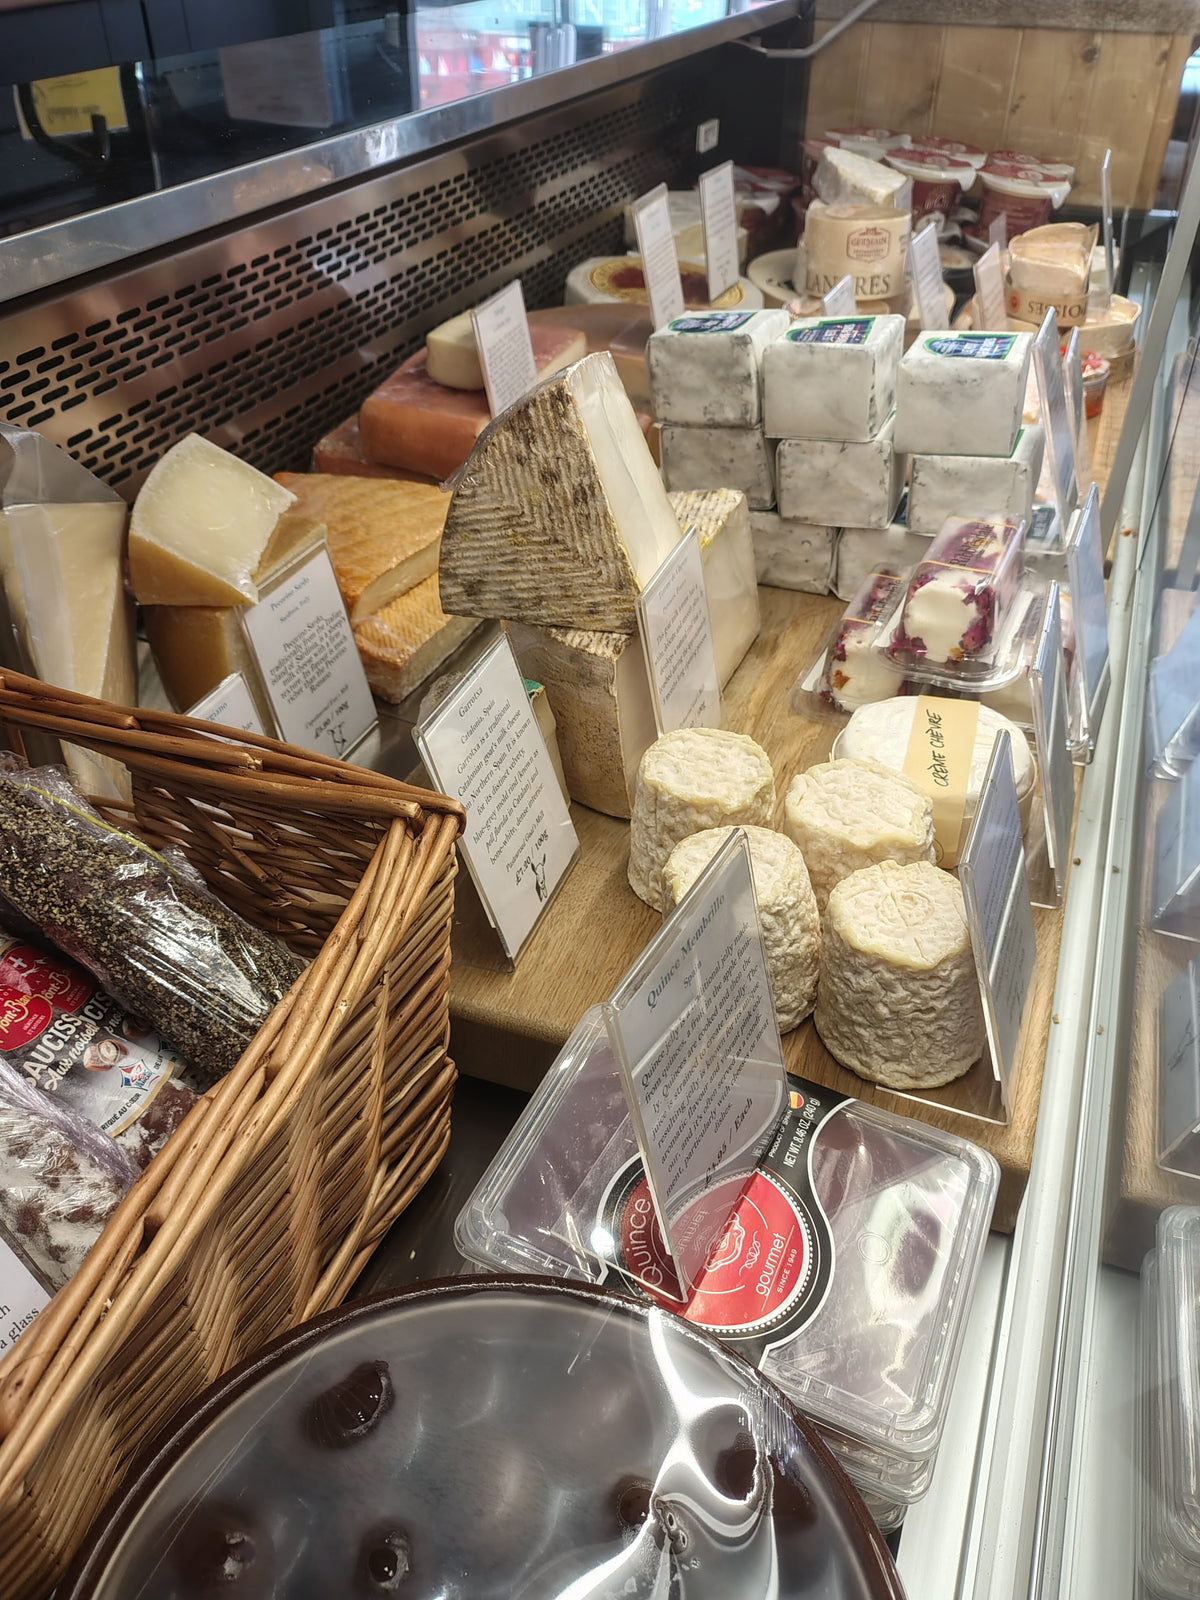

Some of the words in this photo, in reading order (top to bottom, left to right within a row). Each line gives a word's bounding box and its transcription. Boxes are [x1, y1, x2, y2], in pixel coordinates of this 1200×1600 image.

[457, 743, 480, 774] Garrotxa
[479, 736, 485, 745] is
[484, 731, 489, 739] a
[487, 699, 510, 733] traditional
[458, 686, 482, 717] Garrotxa
[460, 716, 484, 744] Catalonia,
[482, 699, 495, 716] Spain
[457, 761, 483, 796] Catalonian
[483, 742, 497, 765] goat's
[496, 727, 507, 744] milk
[506, 709, 520, 730] cheese
[470, 769, 494, 802] Northern
[510, 737, 516, 746] is
[515, 718, 530, 739] known
[476, 802, 486, 815] for
[484, 793, 492, 804] its
[491, 768, 509, 795] distinct
[507, 807, 514, 817] in
[512, 779, 531, 808] Catalan)
[530, 766, 538, 783] and
[472, 809, 497, 844] blue-grey
[495, 789, 509, 812] mold
[507, 775, 518, 794] rind
[516, 756, 533, 782] (known
[647, 959, 679, 1012] Quince
[681, 895, 724, 959] Membrillo
[641, 1050, 664, 1090] Quince
[664, 1026, 679, 1055] jelly
[720, 943, 733, 969] jelly
[645, 1077, 661, 1104] from
[661, 1039, 686, 1078] quinces,
[686, 1029, 691, 1038] a
[690, 1007, 704, 1030] fruit
[704, 997, 712, 1009] in
[712, 981, 722, 998] the
[722, 958, 737, 983] apple
[651, 1110, 666, 1141] juice
[673, 1056, 698, 1100] strained
[698, 1048, 706, 1060] to
[706, 1019, 724, 1048] create
[724, 1004, 733, 1020] the
[746, 964, 758, 982] The
[662, 1056, 686, 1101] Quinces
[687, 1040, 697, 1058] are
[697, 1005, 718, 1041] cooked
[718, 987, 729, 1009] and
[729, 970, 742, 993] then
[741, 956, 750, 971] the
[45, 1057, 74, 1091] Aux
[117, 1105, 129, 1118] AU
[657, 1100, 686, 1148] resulting
[685, 1077, 700, 1106] jelly
[699, 1068, 705, 1081] is
[705, 1036, 725, 1069] known
[725, 1021, 734, 1038] for
[661, 1118, 687, 1164] aromatic
[687, 1082, 708, 1118] flavour
[709, 1061, 720, 1083] and
[720, 1027, 740, 1063] vibrant
[739, 1010, 752, 1035] pink
[666, 1166, 683, 1199] ment,
[684, 1107, 716, 1168] particularly
[717, 1085, 730, 1107] with
[730, 1051, 749, 1086] cheeses
[749, 1039, 755, 1052] or
[755, 1018, 769, 1042] meat
[667, 1152, 680, 1172] our,
[680, 1127, 693, 1150] and
[692, 1113, 703, 1131] it's
[702, 1088, 717, 1114] often
[717, 1054, 735, 1089] served
[735, 1046, 742, 1058] as
[741, 1039, 746, 1047] a
[728, 1127, 732, 1144] /
[734, 1098, 752, 1131] Each
[769, 1133, 783, 1158] PRODUCT
[783, 1151, 796, 1168] NET
[627, 1197, 663, 1287] Quince
[754, 1231, 787, 1297] gourmet
[776, 1269, 791, 1294] SINCE
[786, 1248, 799, 1271] 1949
[0, 1341, 7, 1350] a
[8, 1308, 40, 1343] glass
